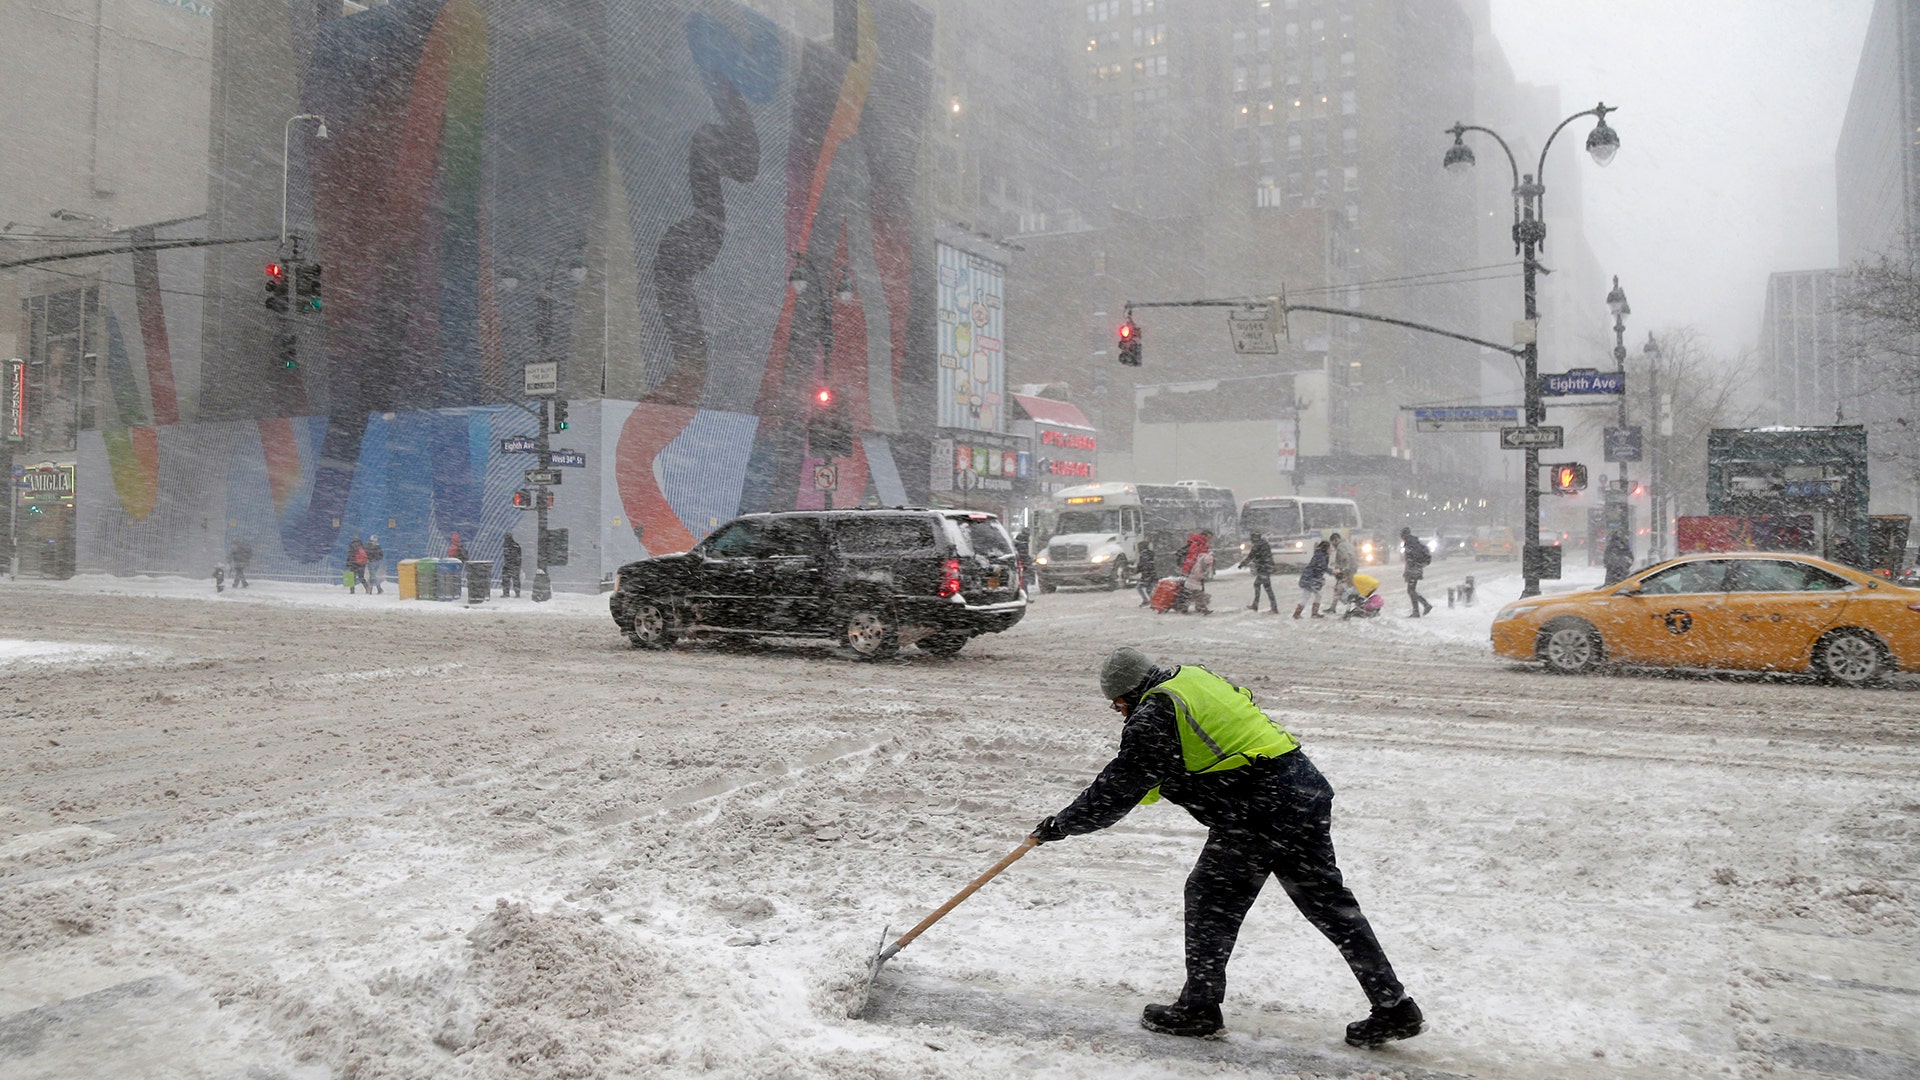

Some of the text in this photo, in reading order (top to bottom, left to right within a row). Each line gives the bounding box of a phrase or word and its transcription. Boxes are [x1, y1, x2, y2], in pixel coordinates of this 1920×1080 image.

[1550, 377, 1616, 392] Eighth Ave
[11, 364, 20, 435] PIZZERIA
[504, 442, 523, 451] Eighth
[552, 455, 583, 464] West 34th St
[27, 473, 69, 491] AMIGLIA
